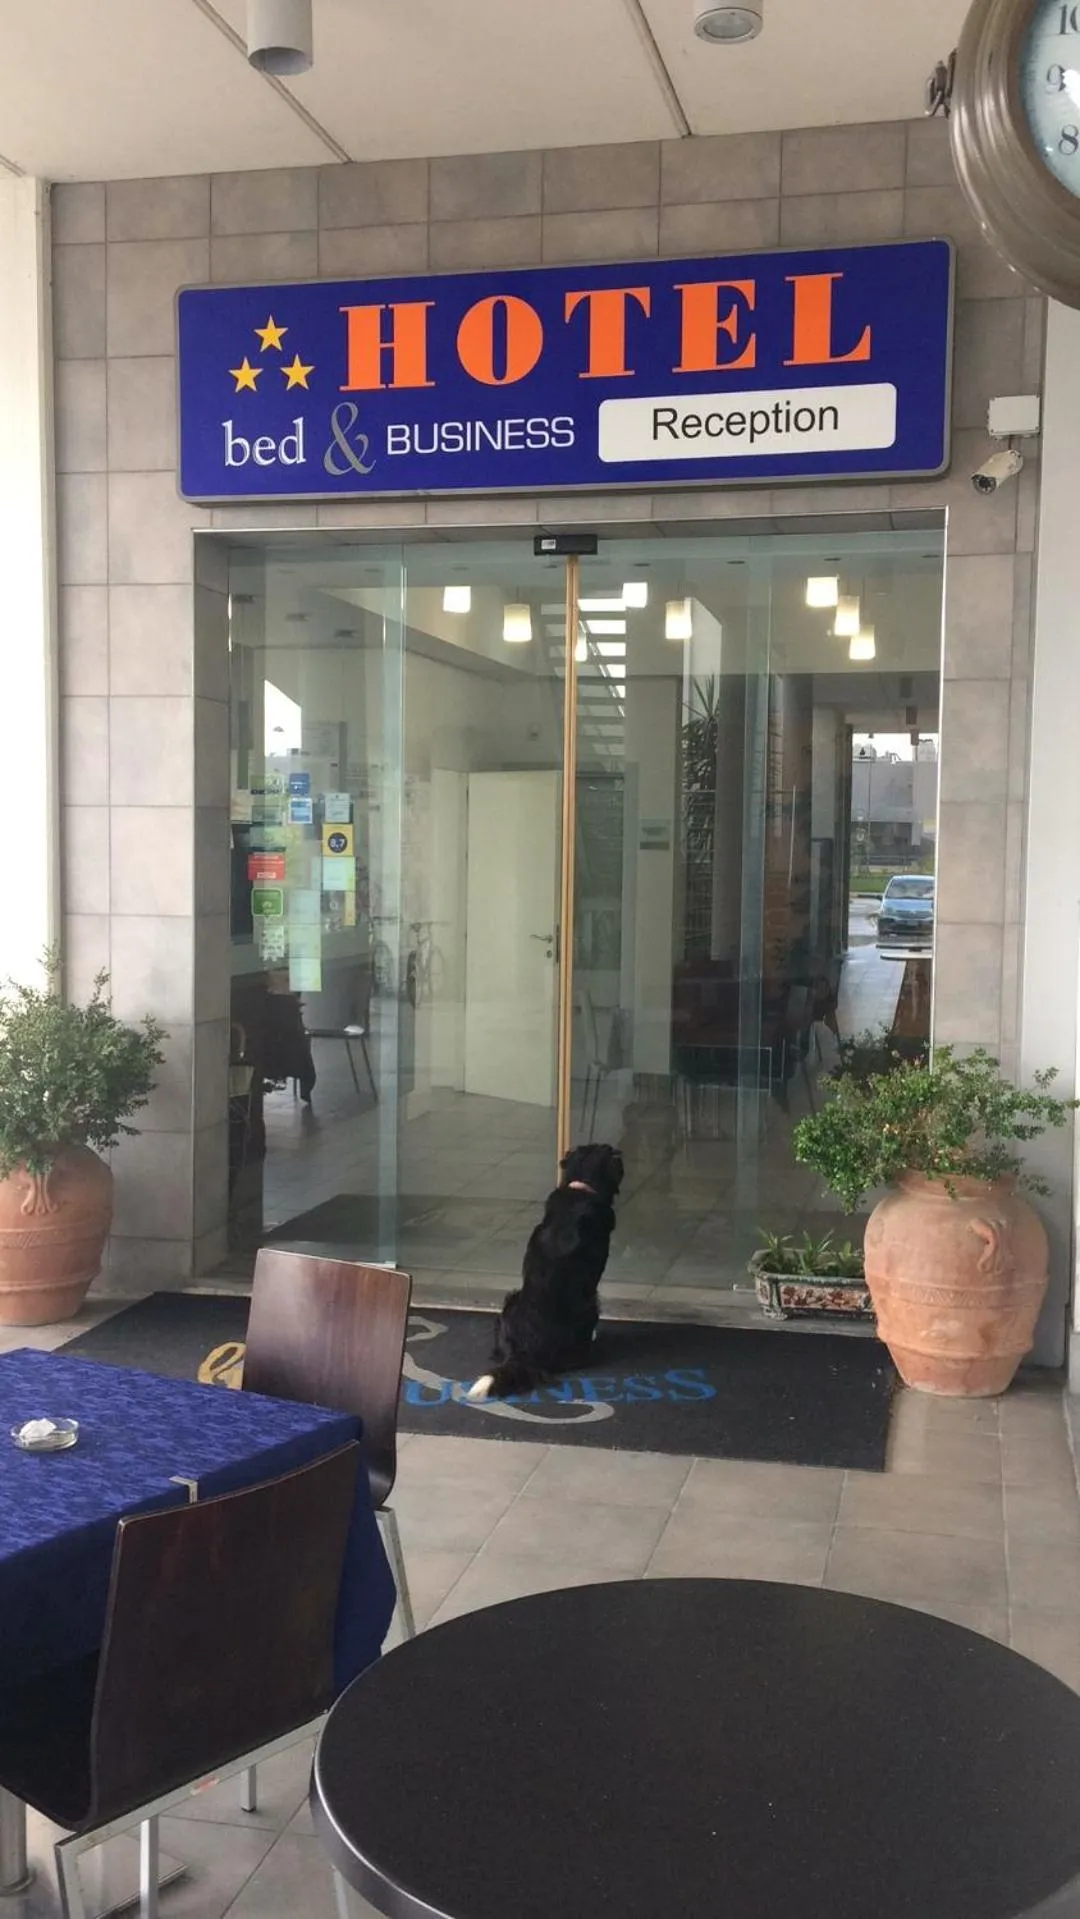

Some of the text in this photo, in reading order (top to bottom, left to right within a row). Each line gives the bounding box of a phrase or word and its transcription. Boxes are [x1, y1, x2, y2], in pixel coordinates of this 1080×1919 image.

[1059, 124, 1079, 155] 8
[339, 272, 872, 391] HOTEL
[222, 402, 575, 475] bed & BUSINESS
[651, 400, 839, 443] Reception
